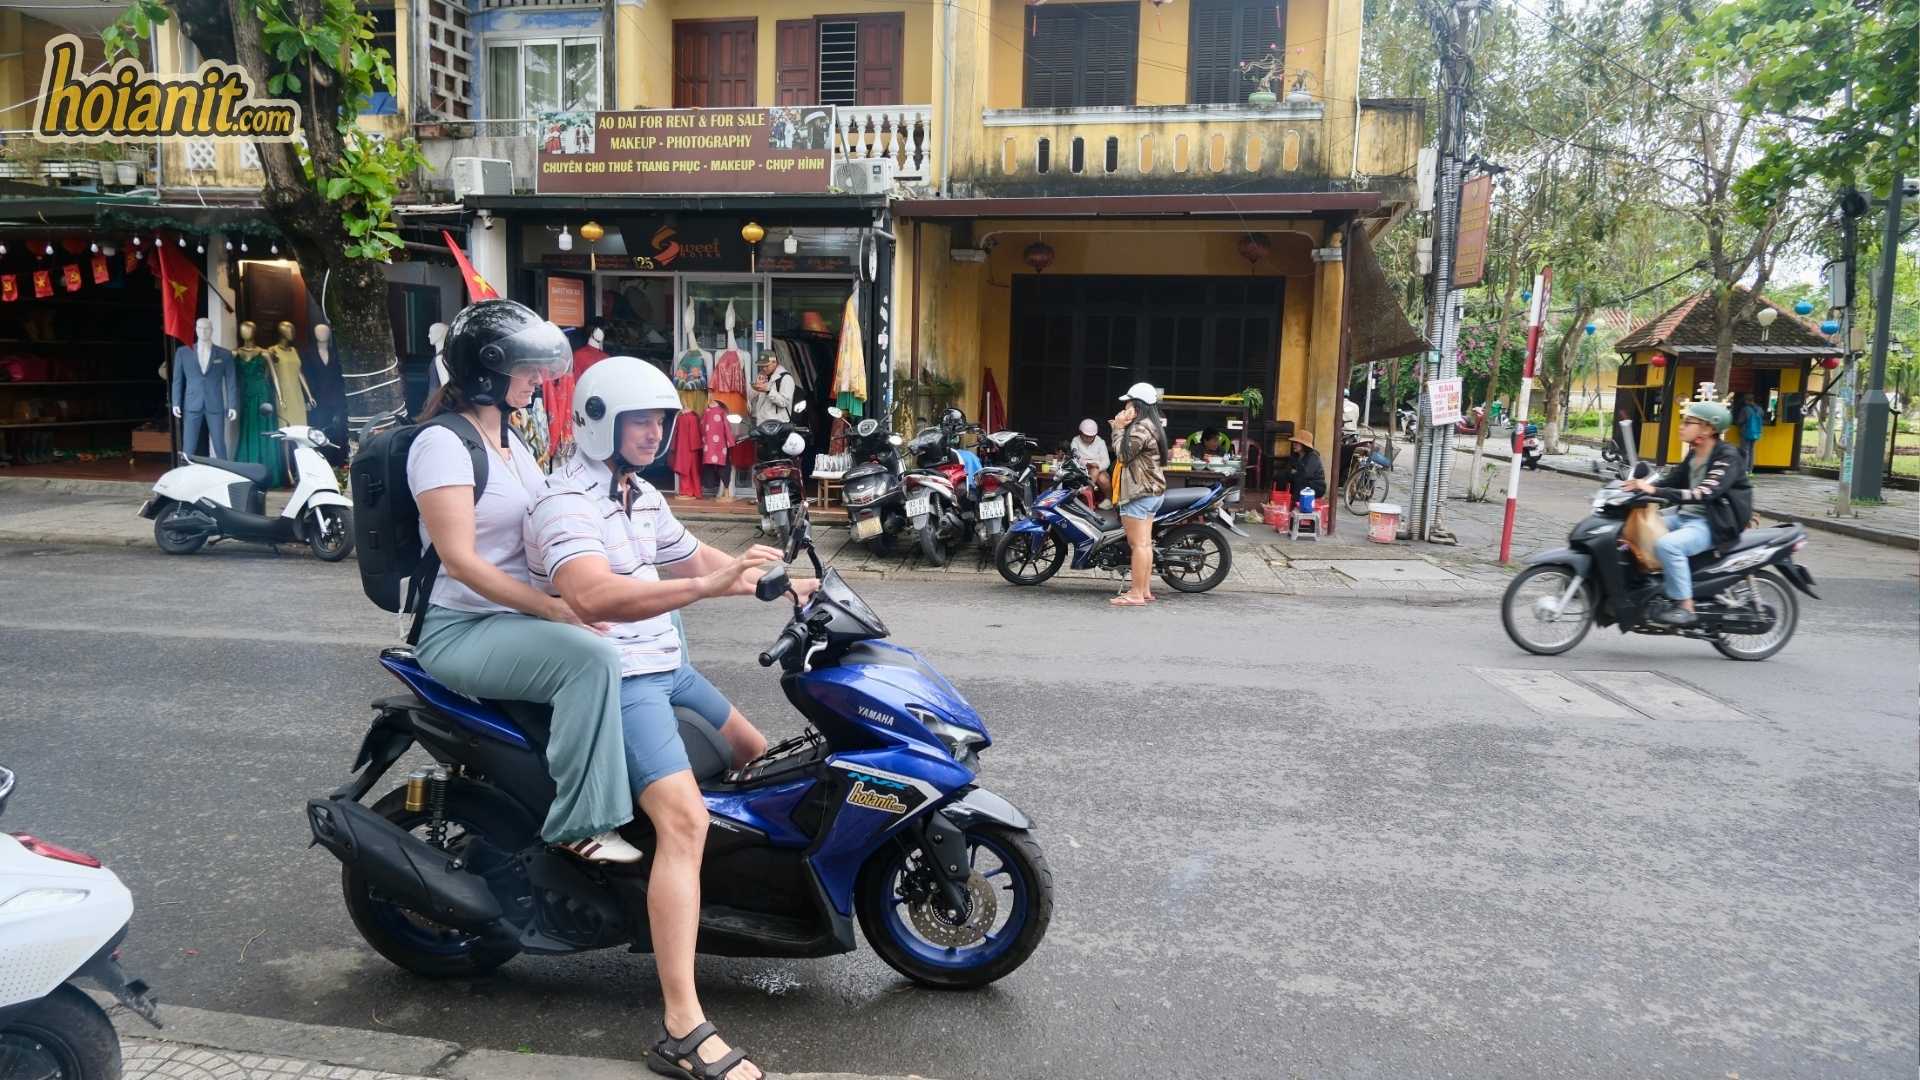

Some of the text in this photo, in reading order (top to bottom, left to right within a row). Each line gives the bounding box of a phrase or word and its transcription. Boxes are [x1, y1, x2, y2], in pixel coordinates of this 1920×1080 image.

[599, 113, 766, 129] AO DAI FOR RENT & FOR SALE
[610, 136, 656, 150] MAKEUP
[666, 134, 753, 149] PHOTOGRAPHY
[543, 160, 583, 173] CHUYÊN
[585, 161, 606, 173] CHO
[608, 159, 633, 172] THUÊ
[637, 160, 670, 172] TRANG
[672, 160, 701, 174] PHỤC
[711, 159, 756, 171] MAKEUP
[766, 158, 795, 173] CHỤP
[798, 156, 825, 170] HÌNH
[858, 706, 895, 726] YAMAHA
